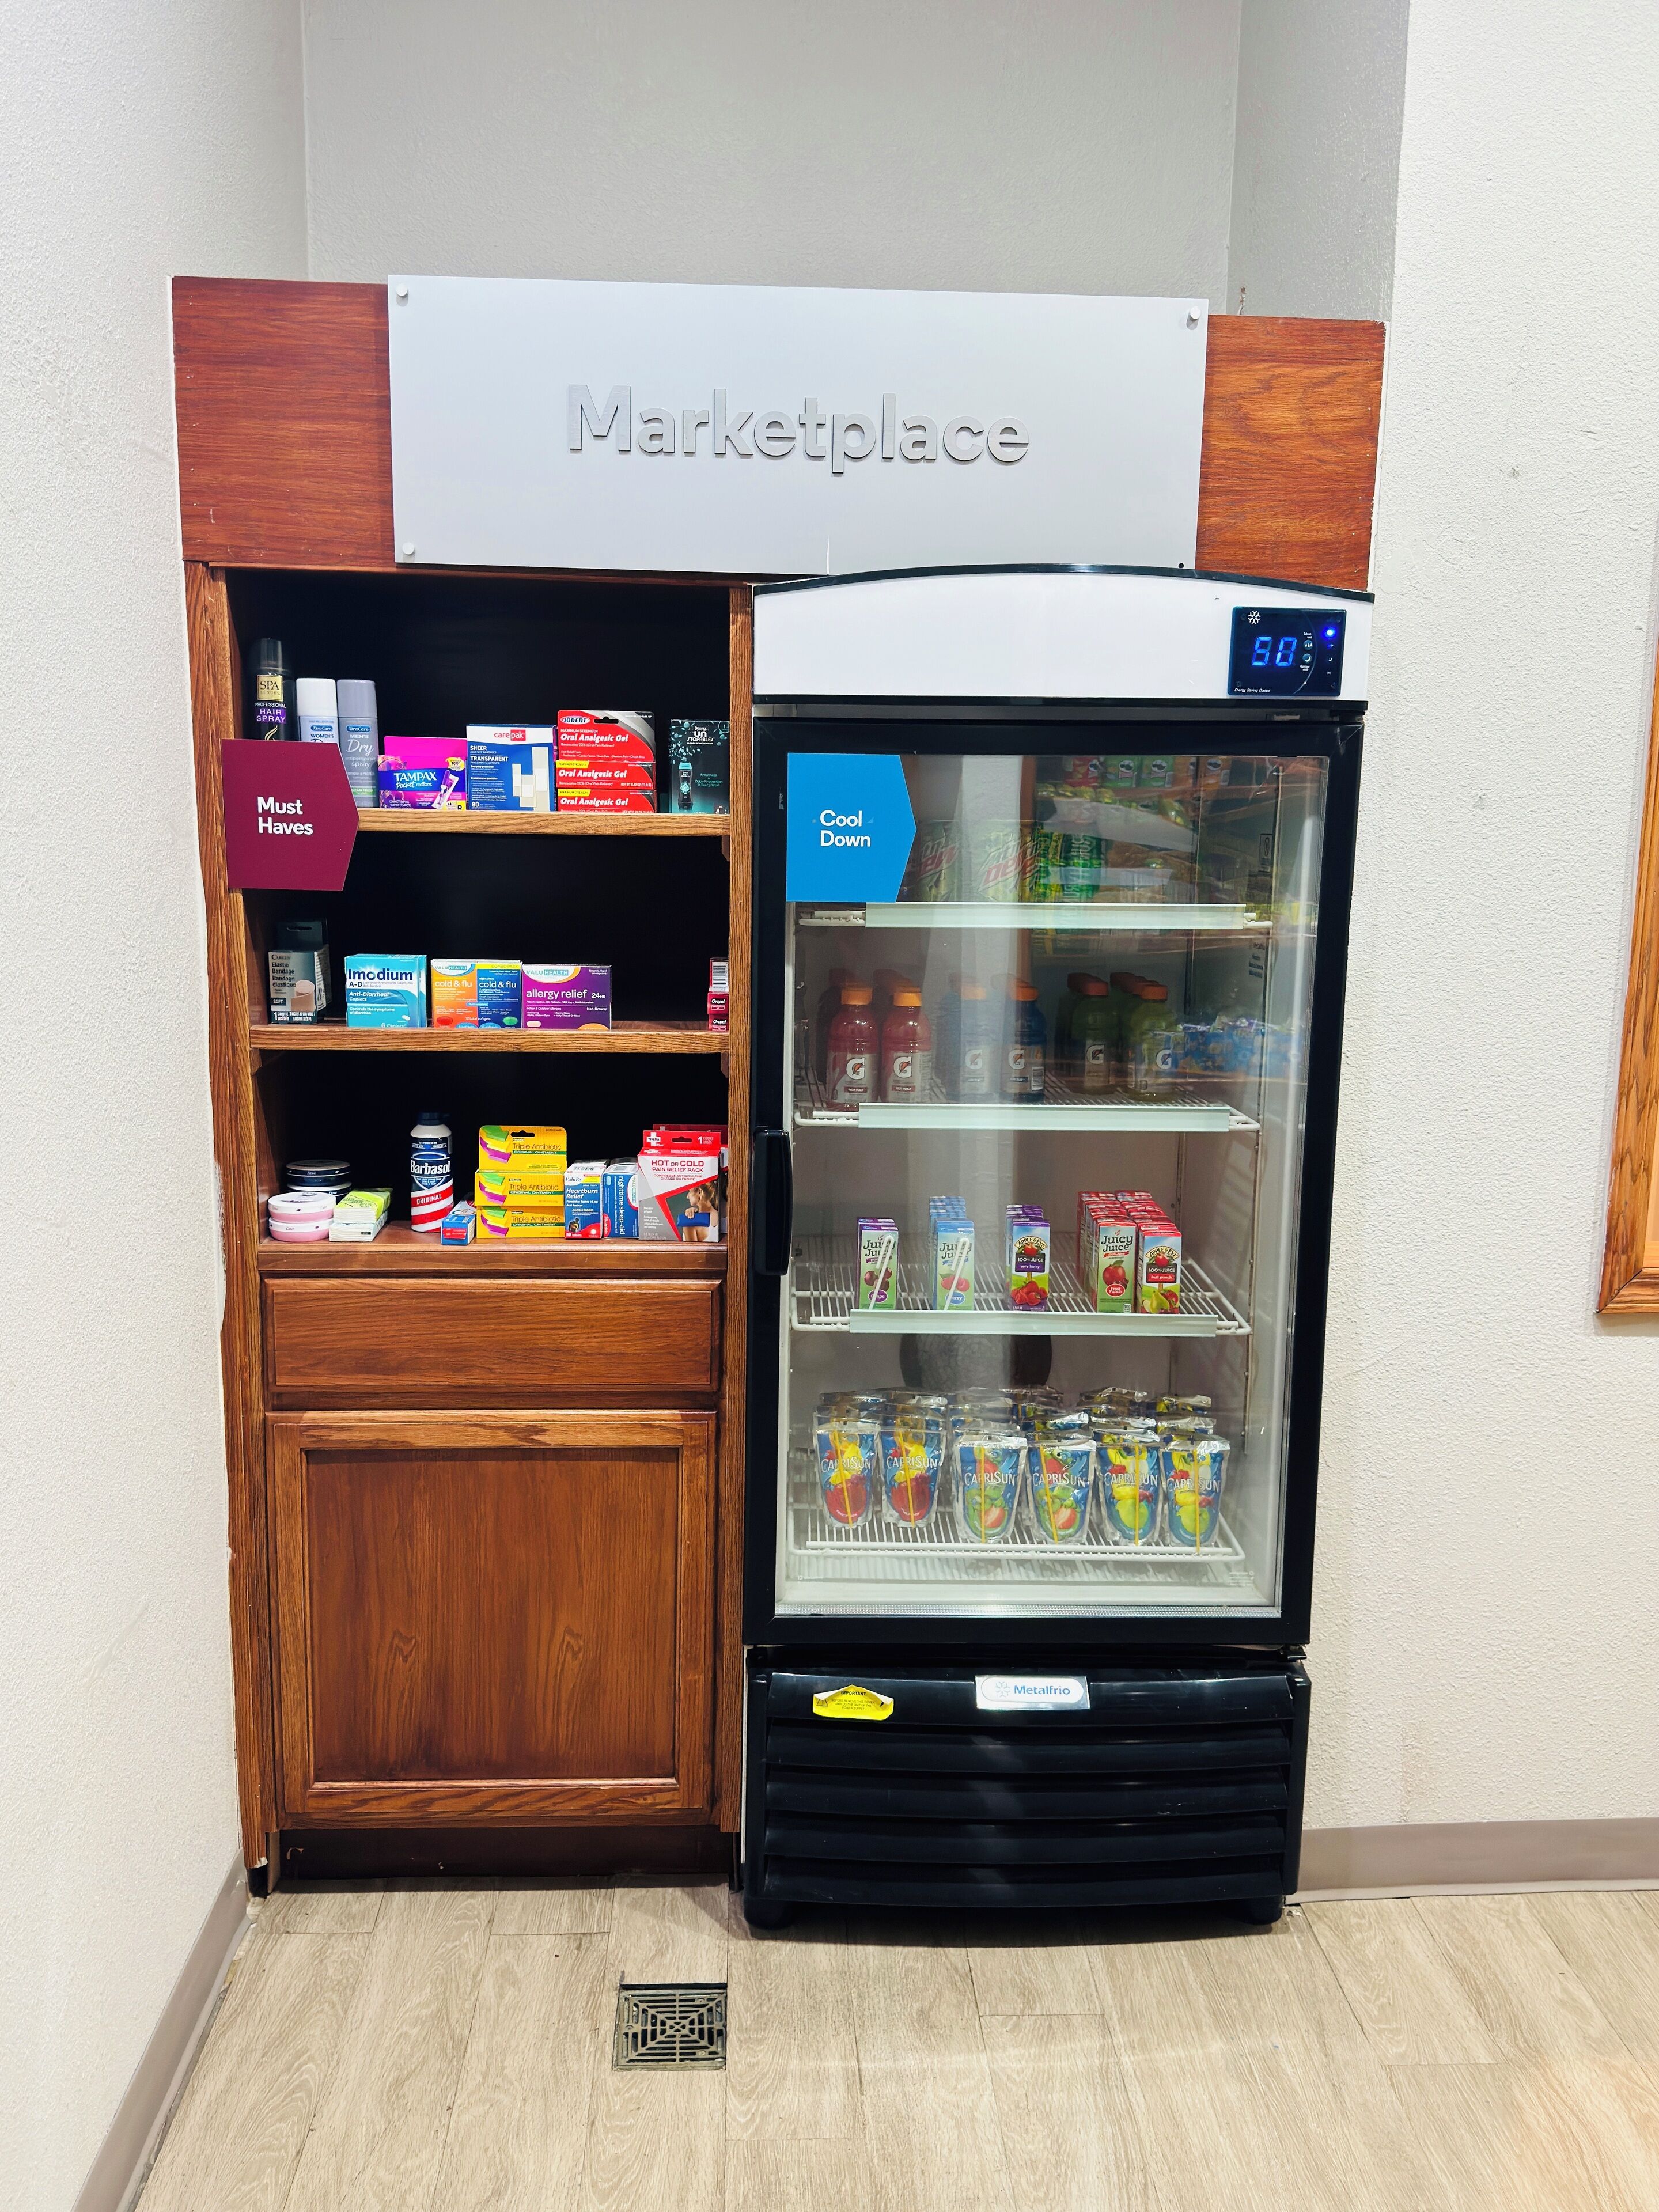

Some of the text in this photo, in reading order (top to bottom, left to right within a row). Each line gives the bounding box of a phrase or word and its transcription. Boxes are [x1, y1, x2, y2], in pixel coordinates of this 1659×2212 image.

[567, 384, 1030, 474] Marketplace
[260, 681, 279, 690] SPA
[579, 734, 614, 743] Analgesic
[346, 739, 374, 756] Dry
[393, 772, 437, 782] TAMPAX
[577, 770, 612, 779] Analgesic
[257, 796, 304, 815] Must
[579, 798, 614, 807] Analgesic
[820, 809, 862, 827] Cool
[258, 817, 313, 835] Haves
[820, 830, 871, 847] Down
[349, 968, 413, 980] Imodium
[527, 988, 559, 1000] allergy
[561, 989, 588, 998] relief
[274, 1012, 277, 1020] 1
[965, 1050, 982, 1069] G
[1009, 1049, 1025, 1069] G
[1086, 1044, 1104, 1064] G
[1156, 1048, 1172, 1069] G
[846, 1058, 865, 1080] G
[893, 1056, 912, 1078] G
[698, 1136, 702, 1144] 1
[411, 1160, 449, 1175] Barbasol
[416, 1194, 442, 1205] ORIGINAL
[1018, 1238, 1033, 1248] APPLE
[1037, 1238, 1046, 1249] EVE
[1101, 1236, 1133, 1245] Juicy
[1103, 1243, 1130, 1252] Juice
[1150, 1248, 1164, 1257] APPLE
[1168, 1249, 1177, 1258] EVE
[1167, 1476, 1219, 1492] CAPRSUN
[1014, 1684, 1070, 1696] Metalfrio
